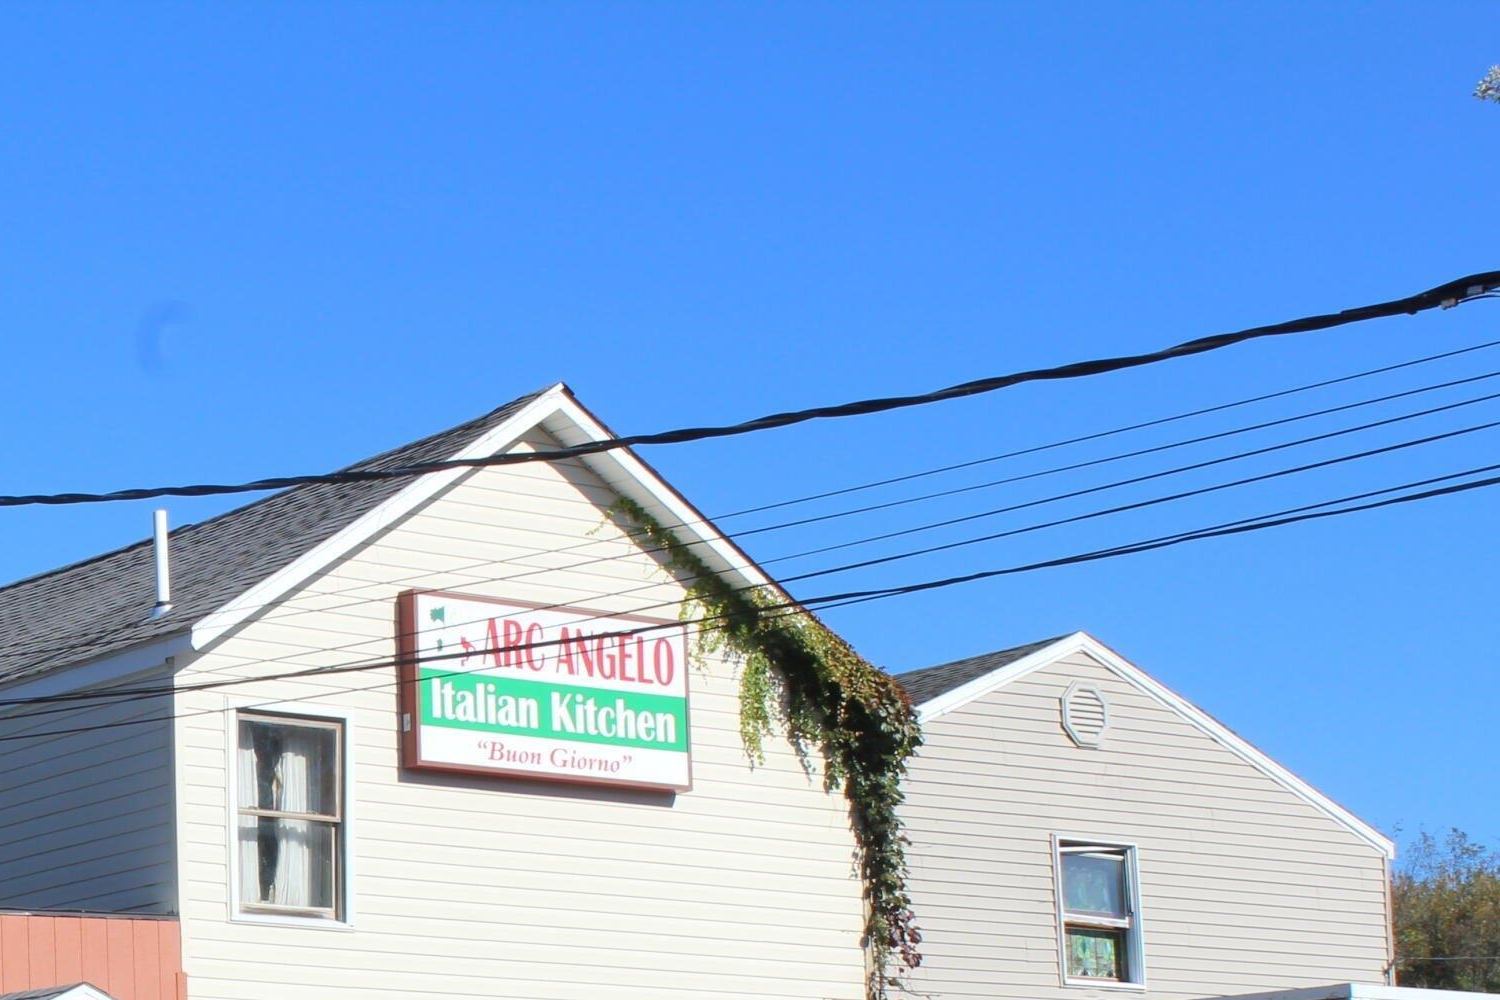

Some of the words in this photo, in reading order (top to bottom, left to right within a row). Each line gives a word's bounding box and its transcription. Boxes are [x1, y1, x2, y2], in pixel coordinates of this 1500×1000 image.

[482, 618, 546, 672] ARC
[556, 626, 675, 687] ANGELO
[431, 677, 539, 730] Italian
[551, 691, 676, 743] Kitchen
[477, 741, 542, 765] “Buon
[550, 748, 633, 773] Giorno”
